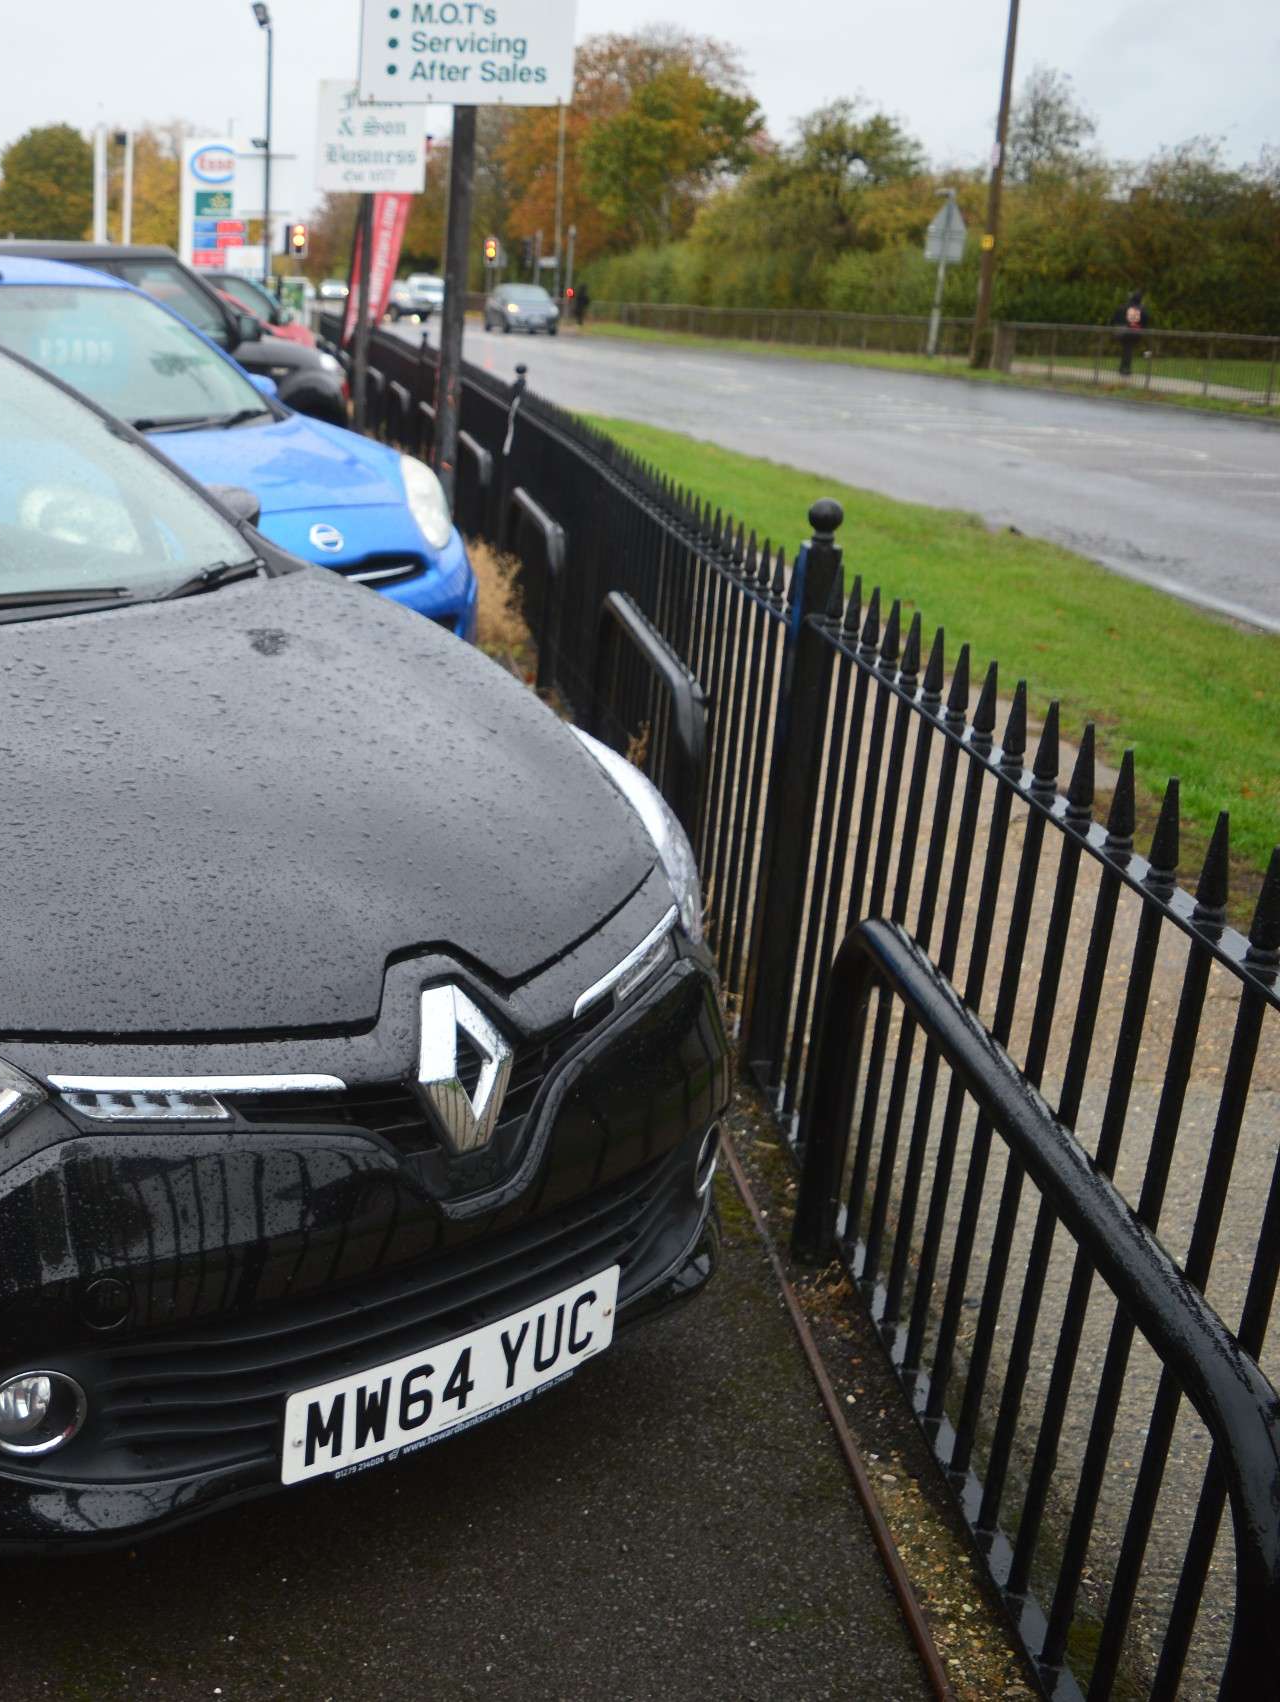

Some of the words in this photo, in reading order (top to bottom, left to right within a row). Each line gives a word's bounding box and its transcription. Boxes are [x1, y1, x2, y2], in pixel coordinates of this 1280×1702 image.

[411, 3, 497, 25] M.O.T's
[411, 31, 528, 60] Servicing
[410, 60, 471, 81] After
[480, 60, 547, 83] Sales
[304, 1346, 474, 1467] MW64
[500, 1290, 597, 1389] YUC
